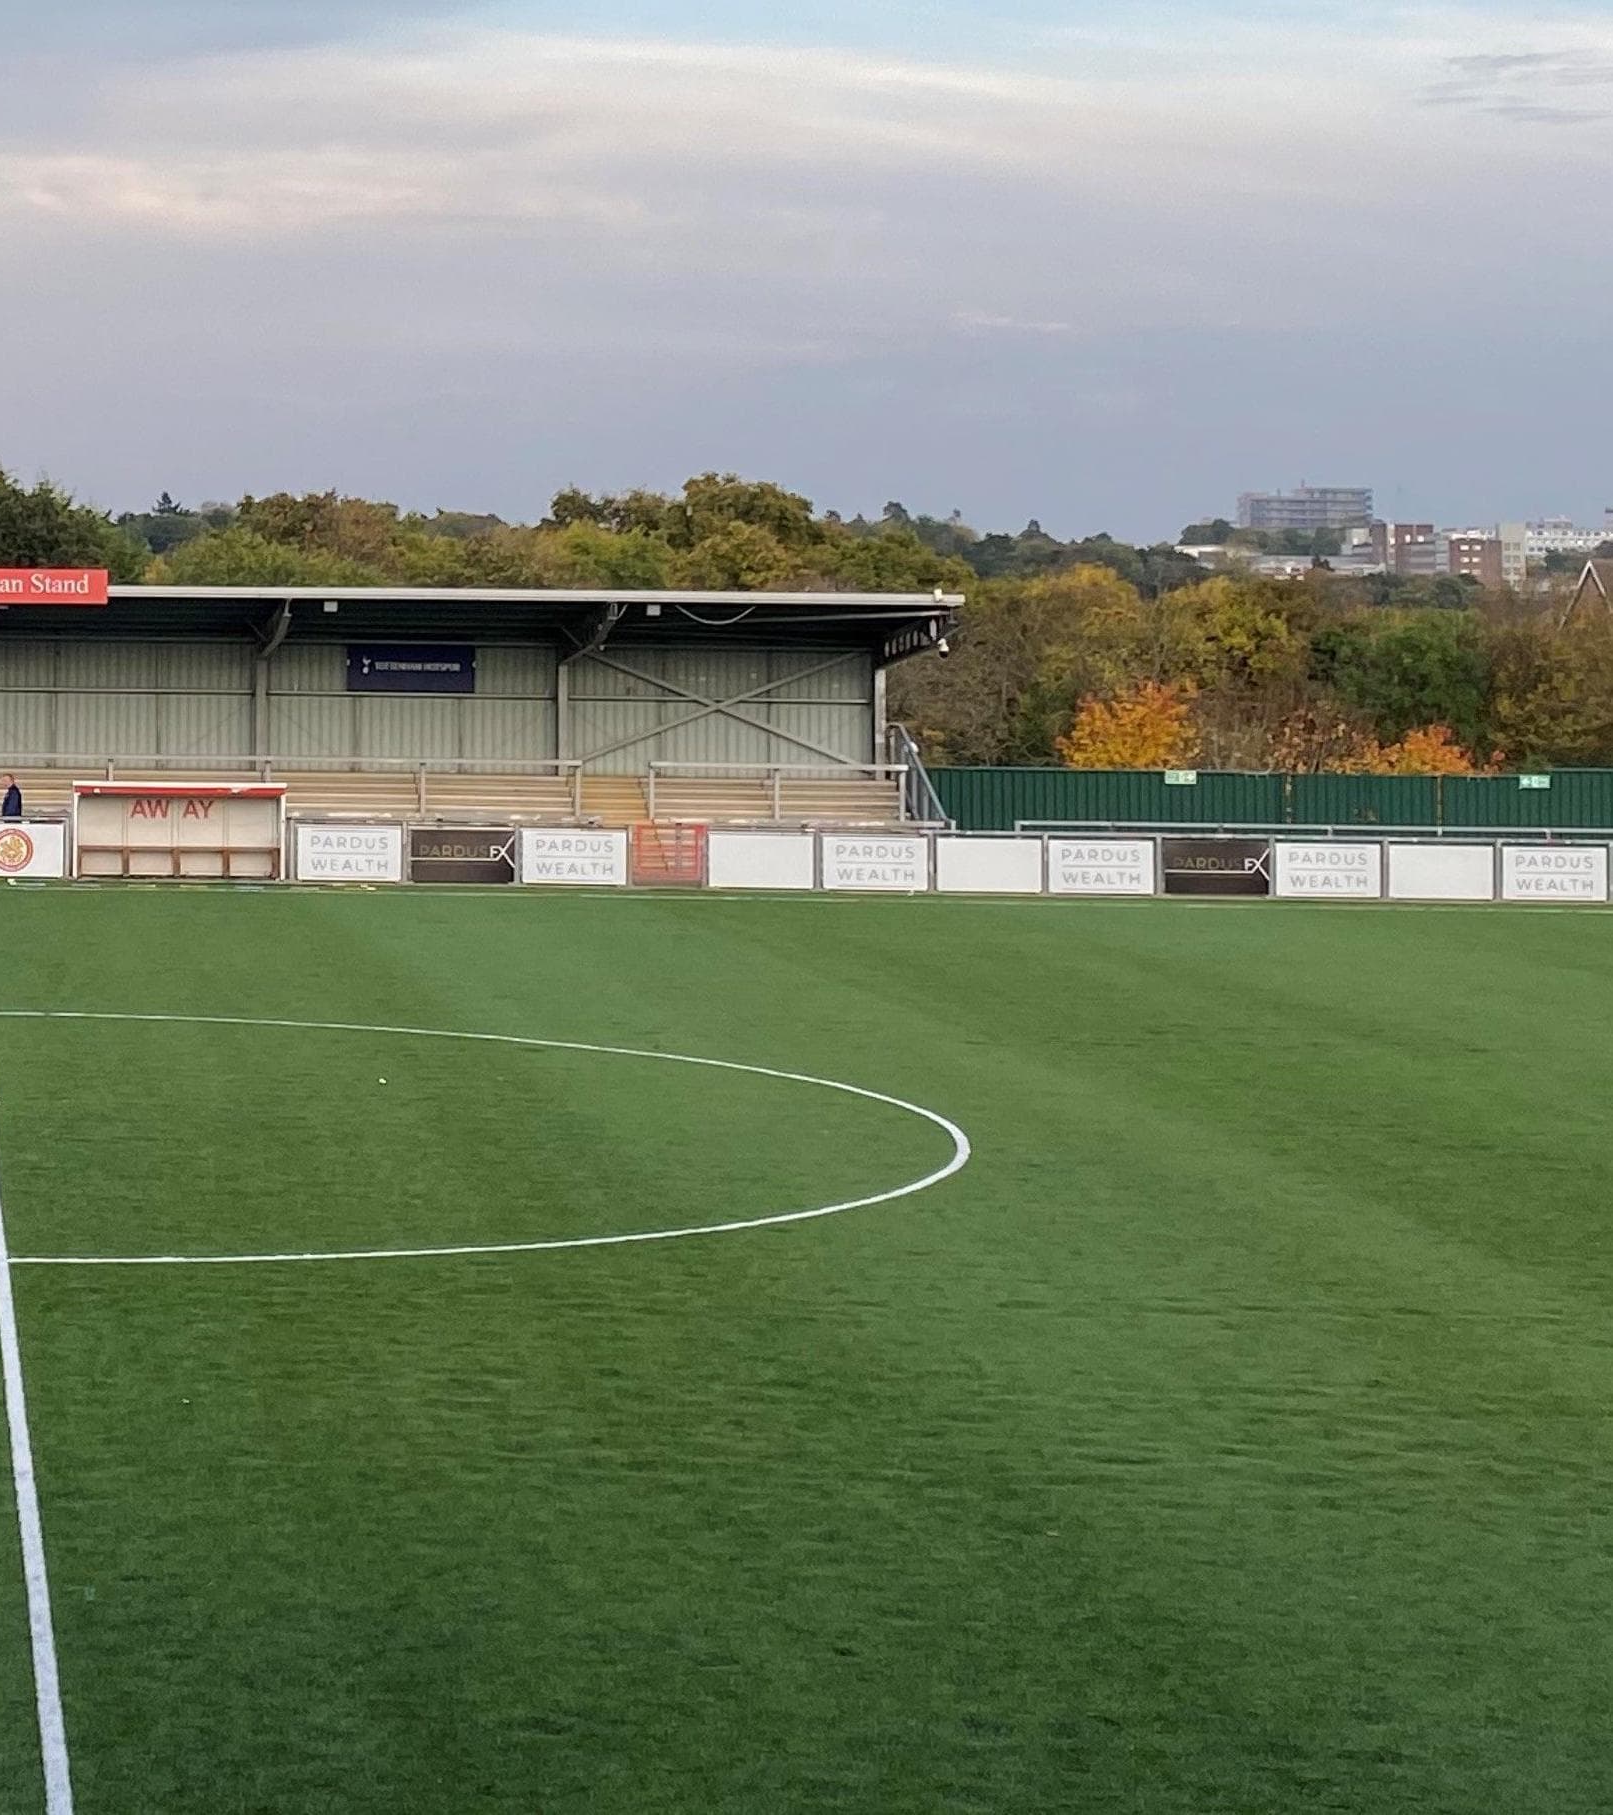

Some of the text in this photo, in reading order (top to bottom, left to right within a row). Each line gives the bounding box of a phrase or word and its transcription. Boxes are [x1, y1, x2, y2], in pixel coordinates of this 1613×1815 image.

[30, 573, 90, 594] Stand
[310, 836, 389, 850] PARDUS
[536, 839, 615, 853] PARDUS
[835, 845, 915, 859] PARDUS
[1061, 848, 1141, 862] PARDUS
[1288, 852, 1368, 866] PARDUS
[310, 859, 389, 873] WEALTH
[536, 862, 615, 876] WEALTH
[1515, 855, 1595, 869] PARDUS
[835, 868, 915, 882] WEALTH
[1061, 871, 1141, 885] WEALTH
[1288, 875, 1368, 889] WEALTH
[1515, 878, 1595, 892] WEALTH
